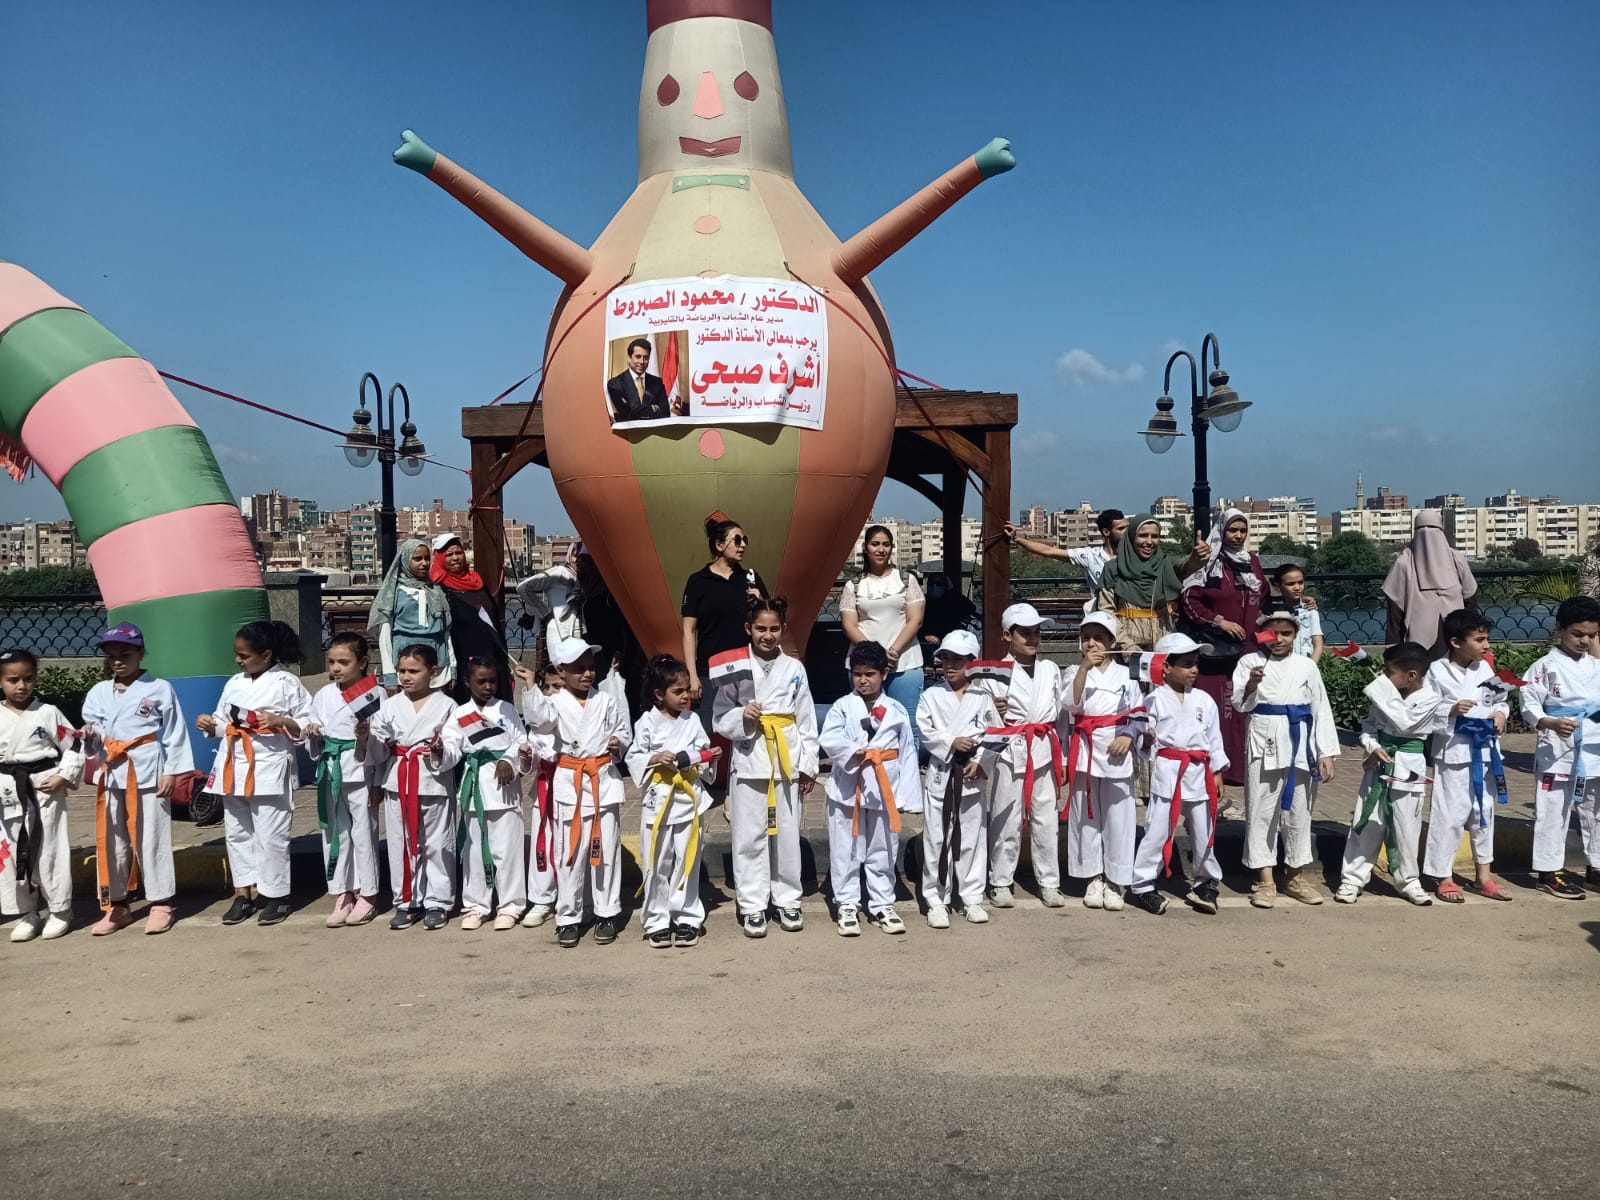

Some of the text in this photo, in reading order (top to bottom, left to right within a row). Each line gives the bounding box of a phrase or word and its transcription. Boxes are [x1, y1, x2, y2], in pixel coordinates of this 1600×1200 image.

[613, 288, 819, 319] الدكتور / محمود الصبروط
[648, 312, 784, 326] مدير عام الشباب والرياضة بالقليوبية
[696, 328, 734, 345] الدكتور
[796, 336, 818, 352] يرحب
[769, 352, 820, 395] أشرف
[701, 394, 811, 413] وزير الشباب والرياضة
